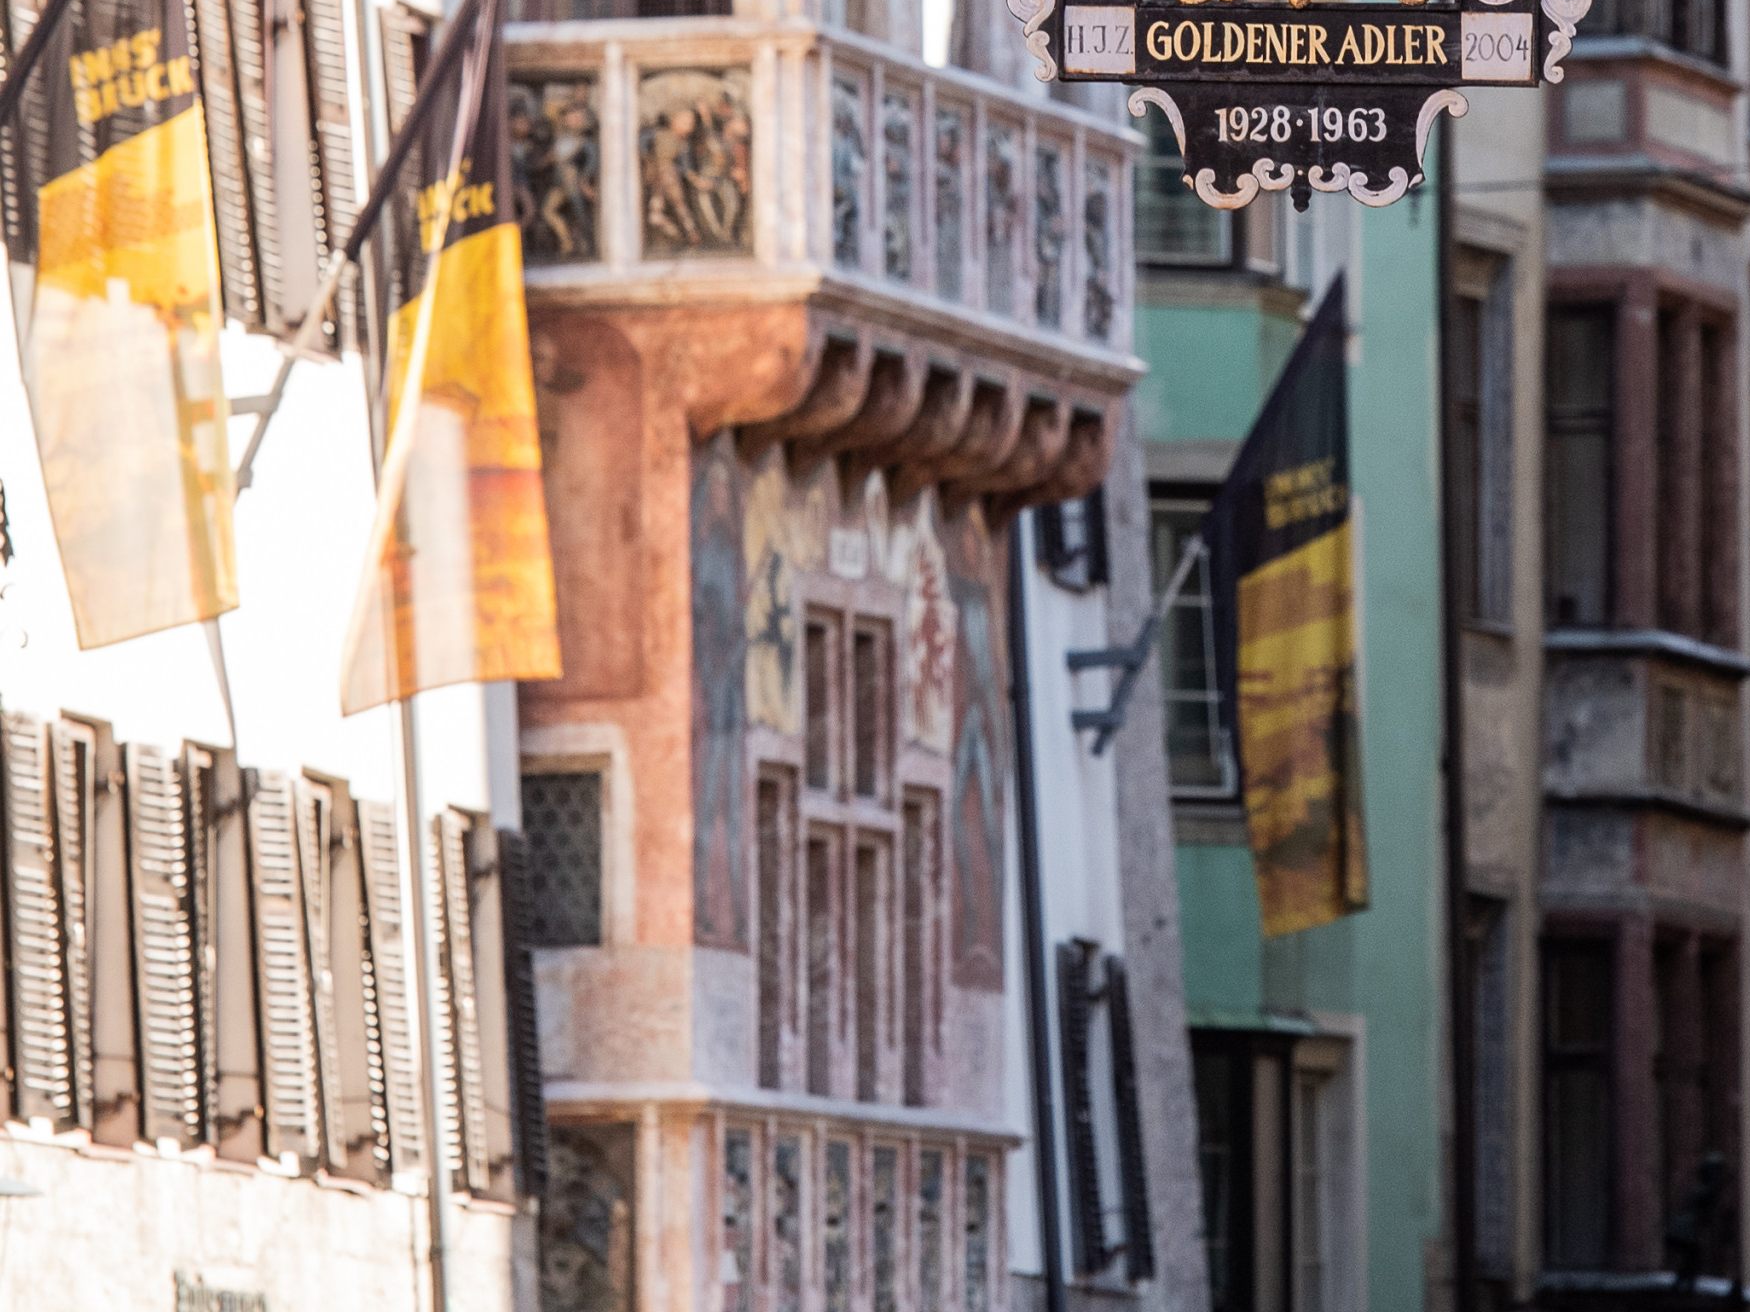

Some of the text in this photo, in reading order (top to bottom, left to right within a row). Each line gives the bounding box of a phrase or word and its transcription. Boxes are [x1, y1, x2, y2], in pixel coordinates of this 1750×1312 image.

[1146, 20, 1449, 66] GOLDENER ADLER
[1464, 32, 1530, 63] 2004
